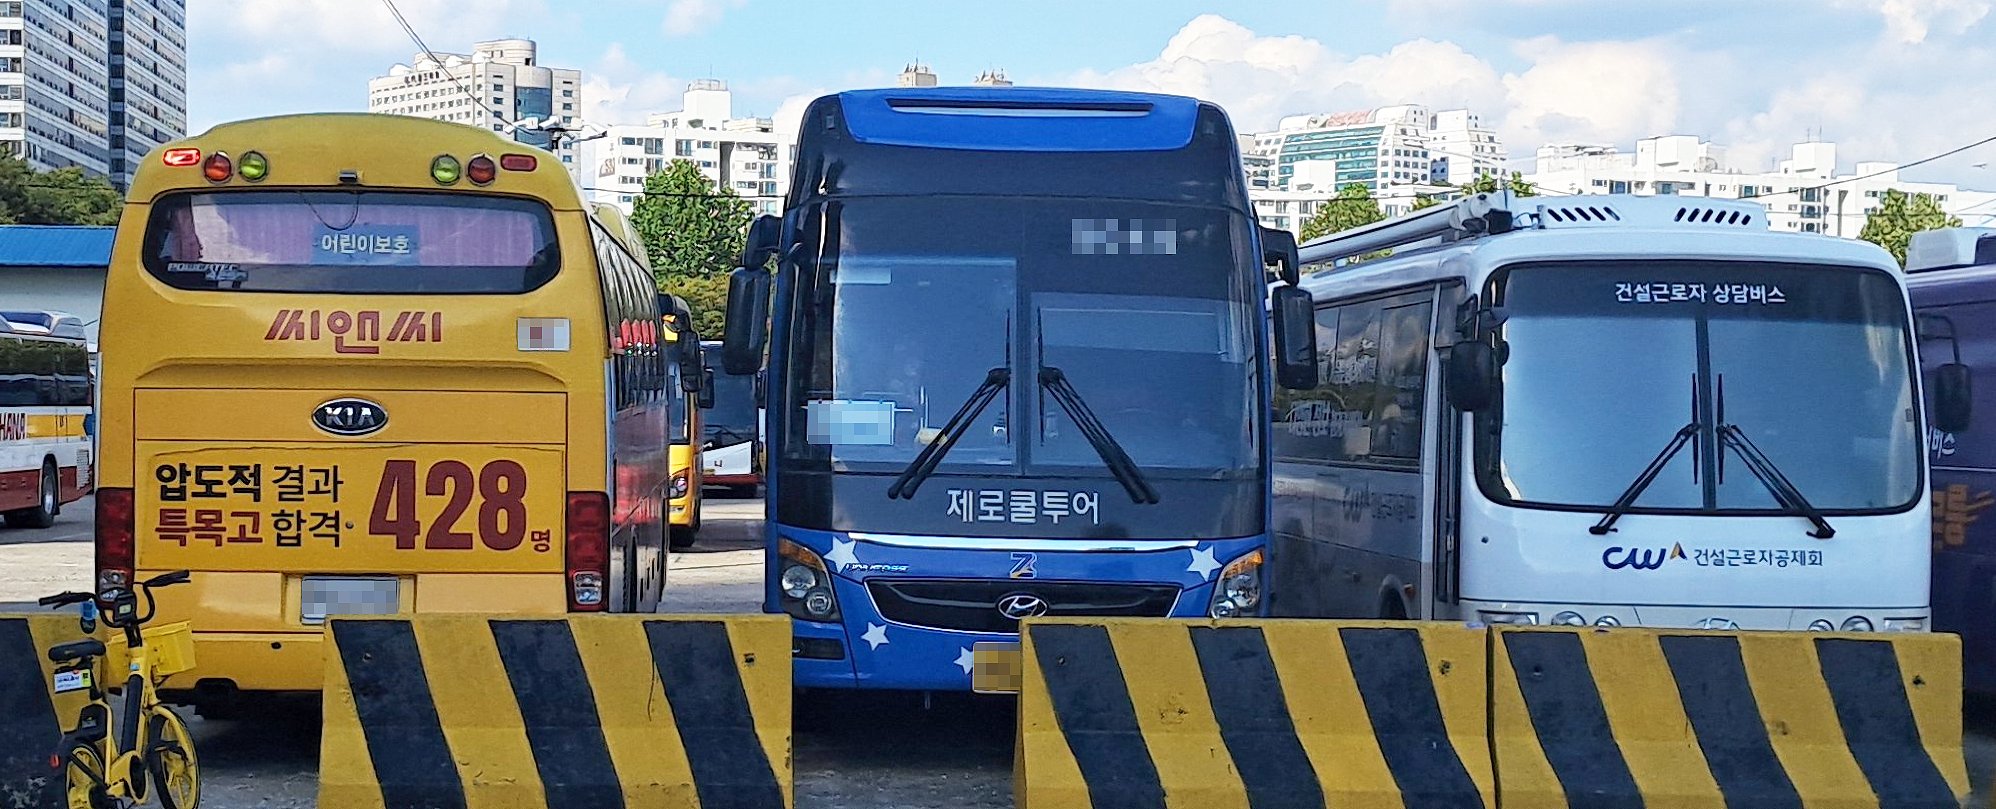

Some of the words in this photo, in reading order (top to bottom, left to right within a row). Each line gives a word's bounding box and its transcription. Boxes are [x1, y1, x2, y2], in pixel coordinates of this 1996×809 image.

[321, 233, 411, 255] 어린이보호
[1615, 283, 1708, 303] 건설근로자
[1712, 283, 1787, 304] 상담버스
[264, 309, 442, 354] 씨앤씨
[324, 406, 376, 427] KIA
[1928, 425, 1956, 460] 버스
[155, 462, 262, 502] 압도적
[271, 464, 344, 502] 결과
[946, 488, 1099, 525] 제로쿨투어
[155, 508, 263, 547] 특목고
[271, 509, 341, 548] 합격
[1693, 548, 1824, 568] 건설근로자공제회
